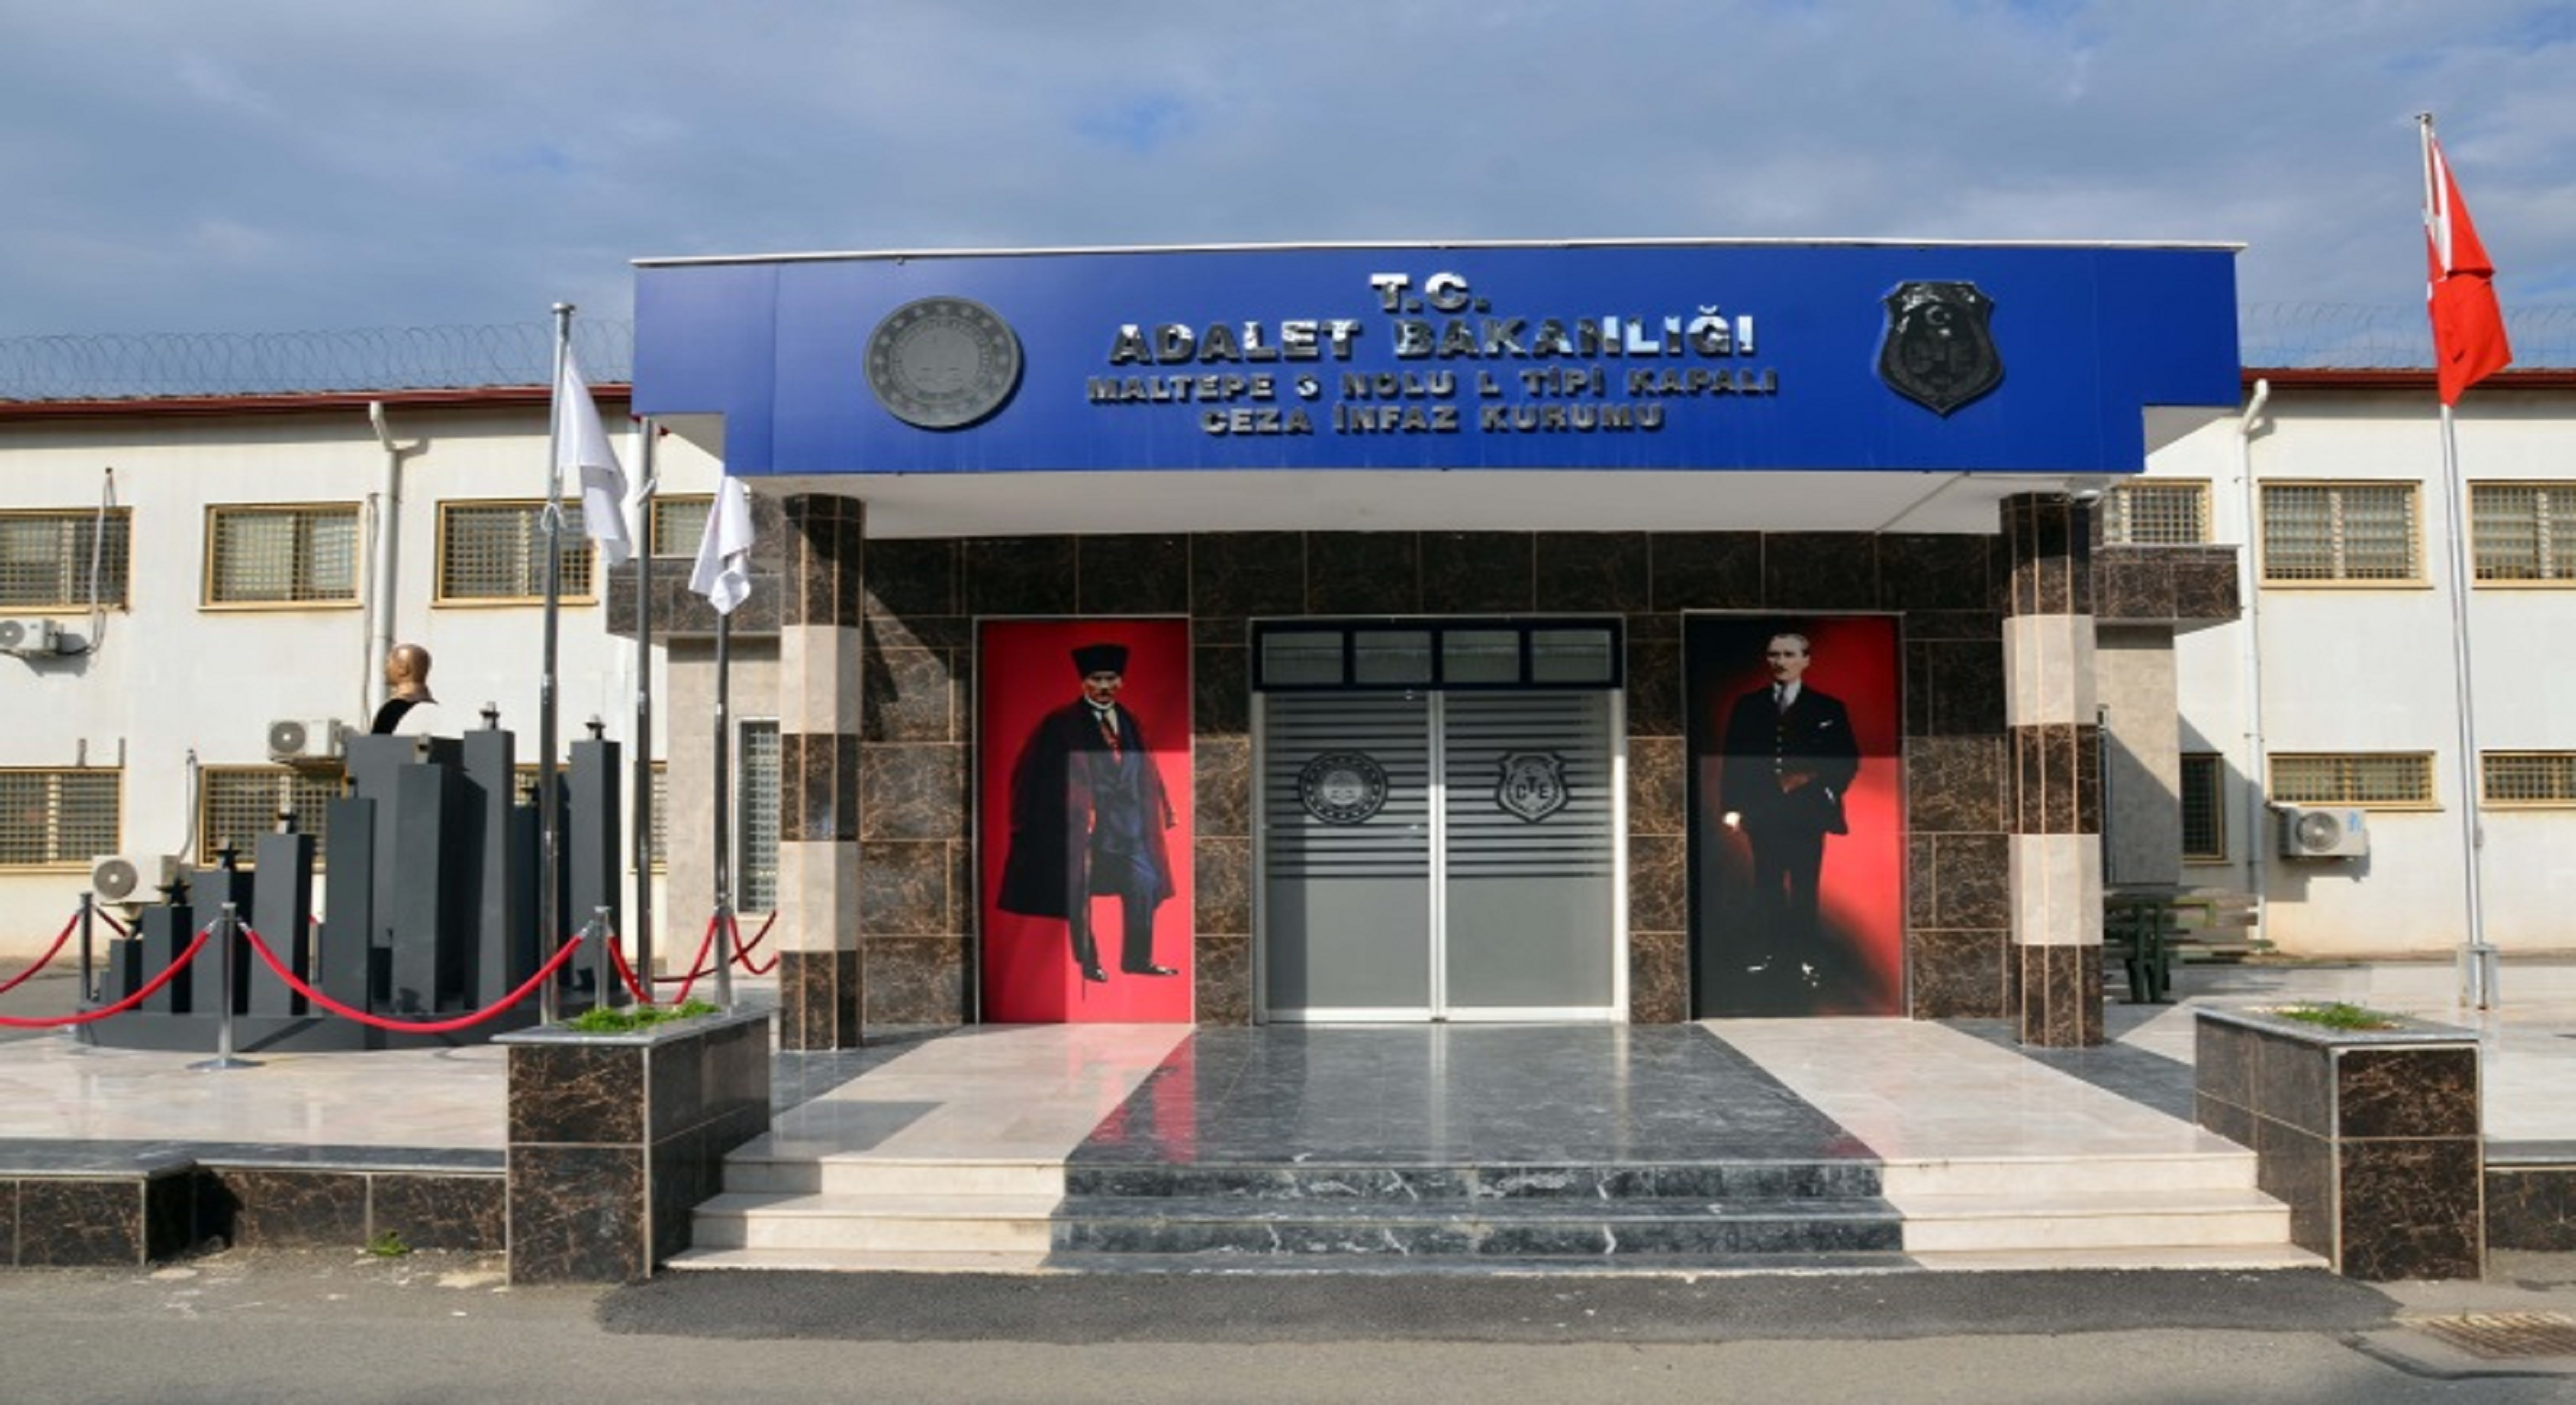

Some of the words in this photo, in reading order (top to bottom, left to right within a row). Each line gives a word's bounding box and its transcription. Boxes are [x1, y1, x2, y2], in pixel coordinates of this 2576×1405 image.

[1370, 273, 1489, 312] T.C.
[1110, 319, 1359, 365] ADALET
[1394, 305, 1756, 358] BAKANLIĞI
[1088, 374, 1277, 402] MALTEPE
[1341, 370, 1456, 399] NOLU
[1477, 370, 1503, 396] L
[1519, 364, 1603, 396] TİPİ
[1626, 367, 1778, 395] KAPALI
[1199, 407, 1313, 435] CEZA
[1333, 401, 1460, 431] İNFAZ
[1480, 402, 1667, 430] KURUMU
